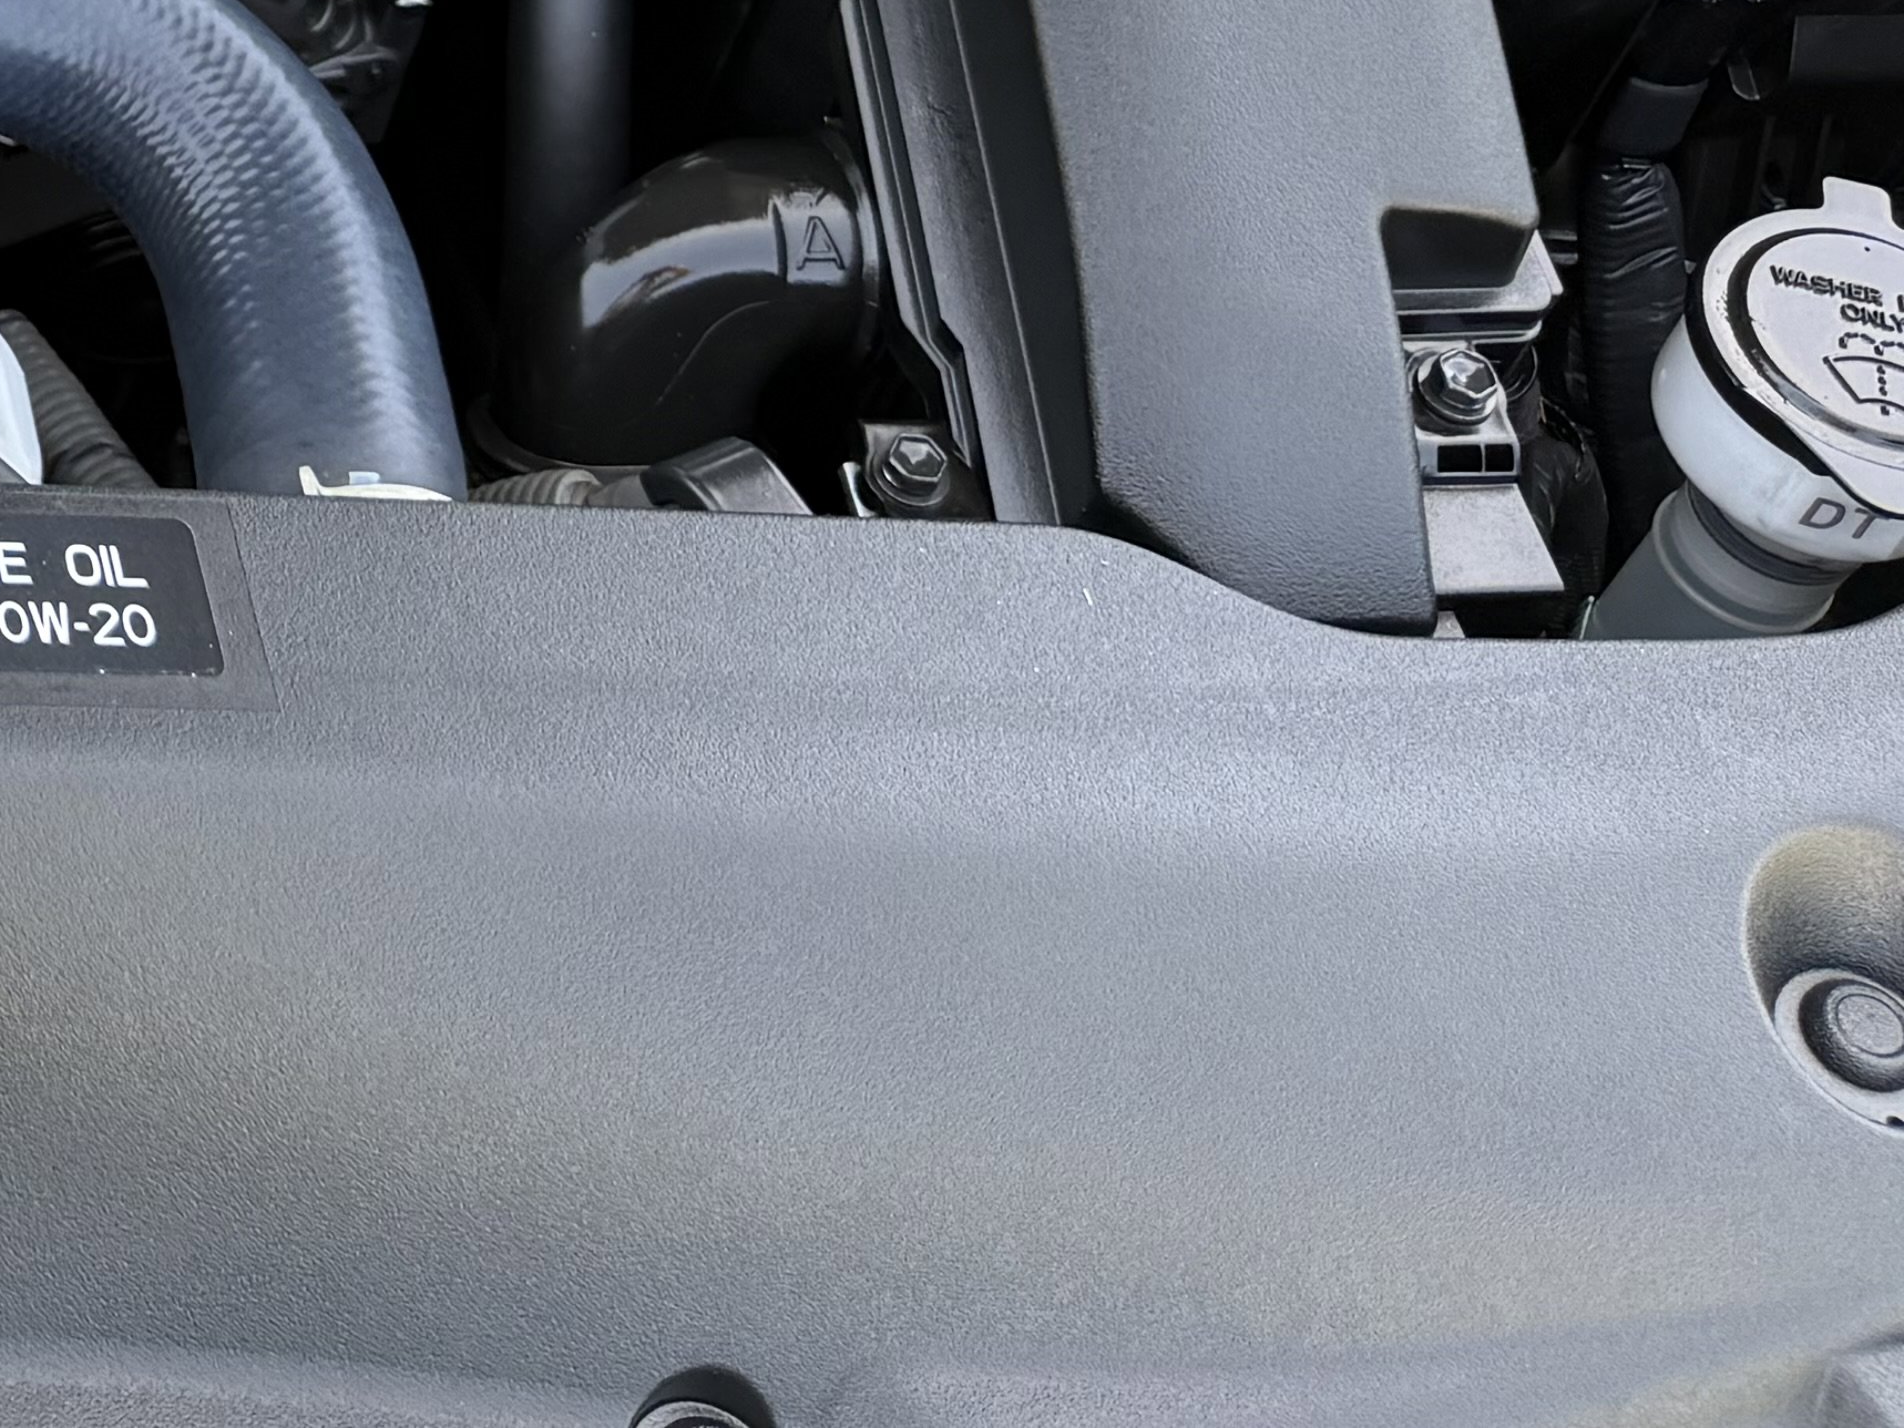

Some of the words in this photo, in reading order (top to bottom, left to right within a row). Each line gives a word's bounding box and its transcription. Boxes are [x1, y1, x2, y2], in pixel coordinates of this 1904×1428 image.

[1769, 264, 1885, 308] WASHER
[1840, 302, 1904, 334] ONLY
[64, 543, 151, 589] OIL
